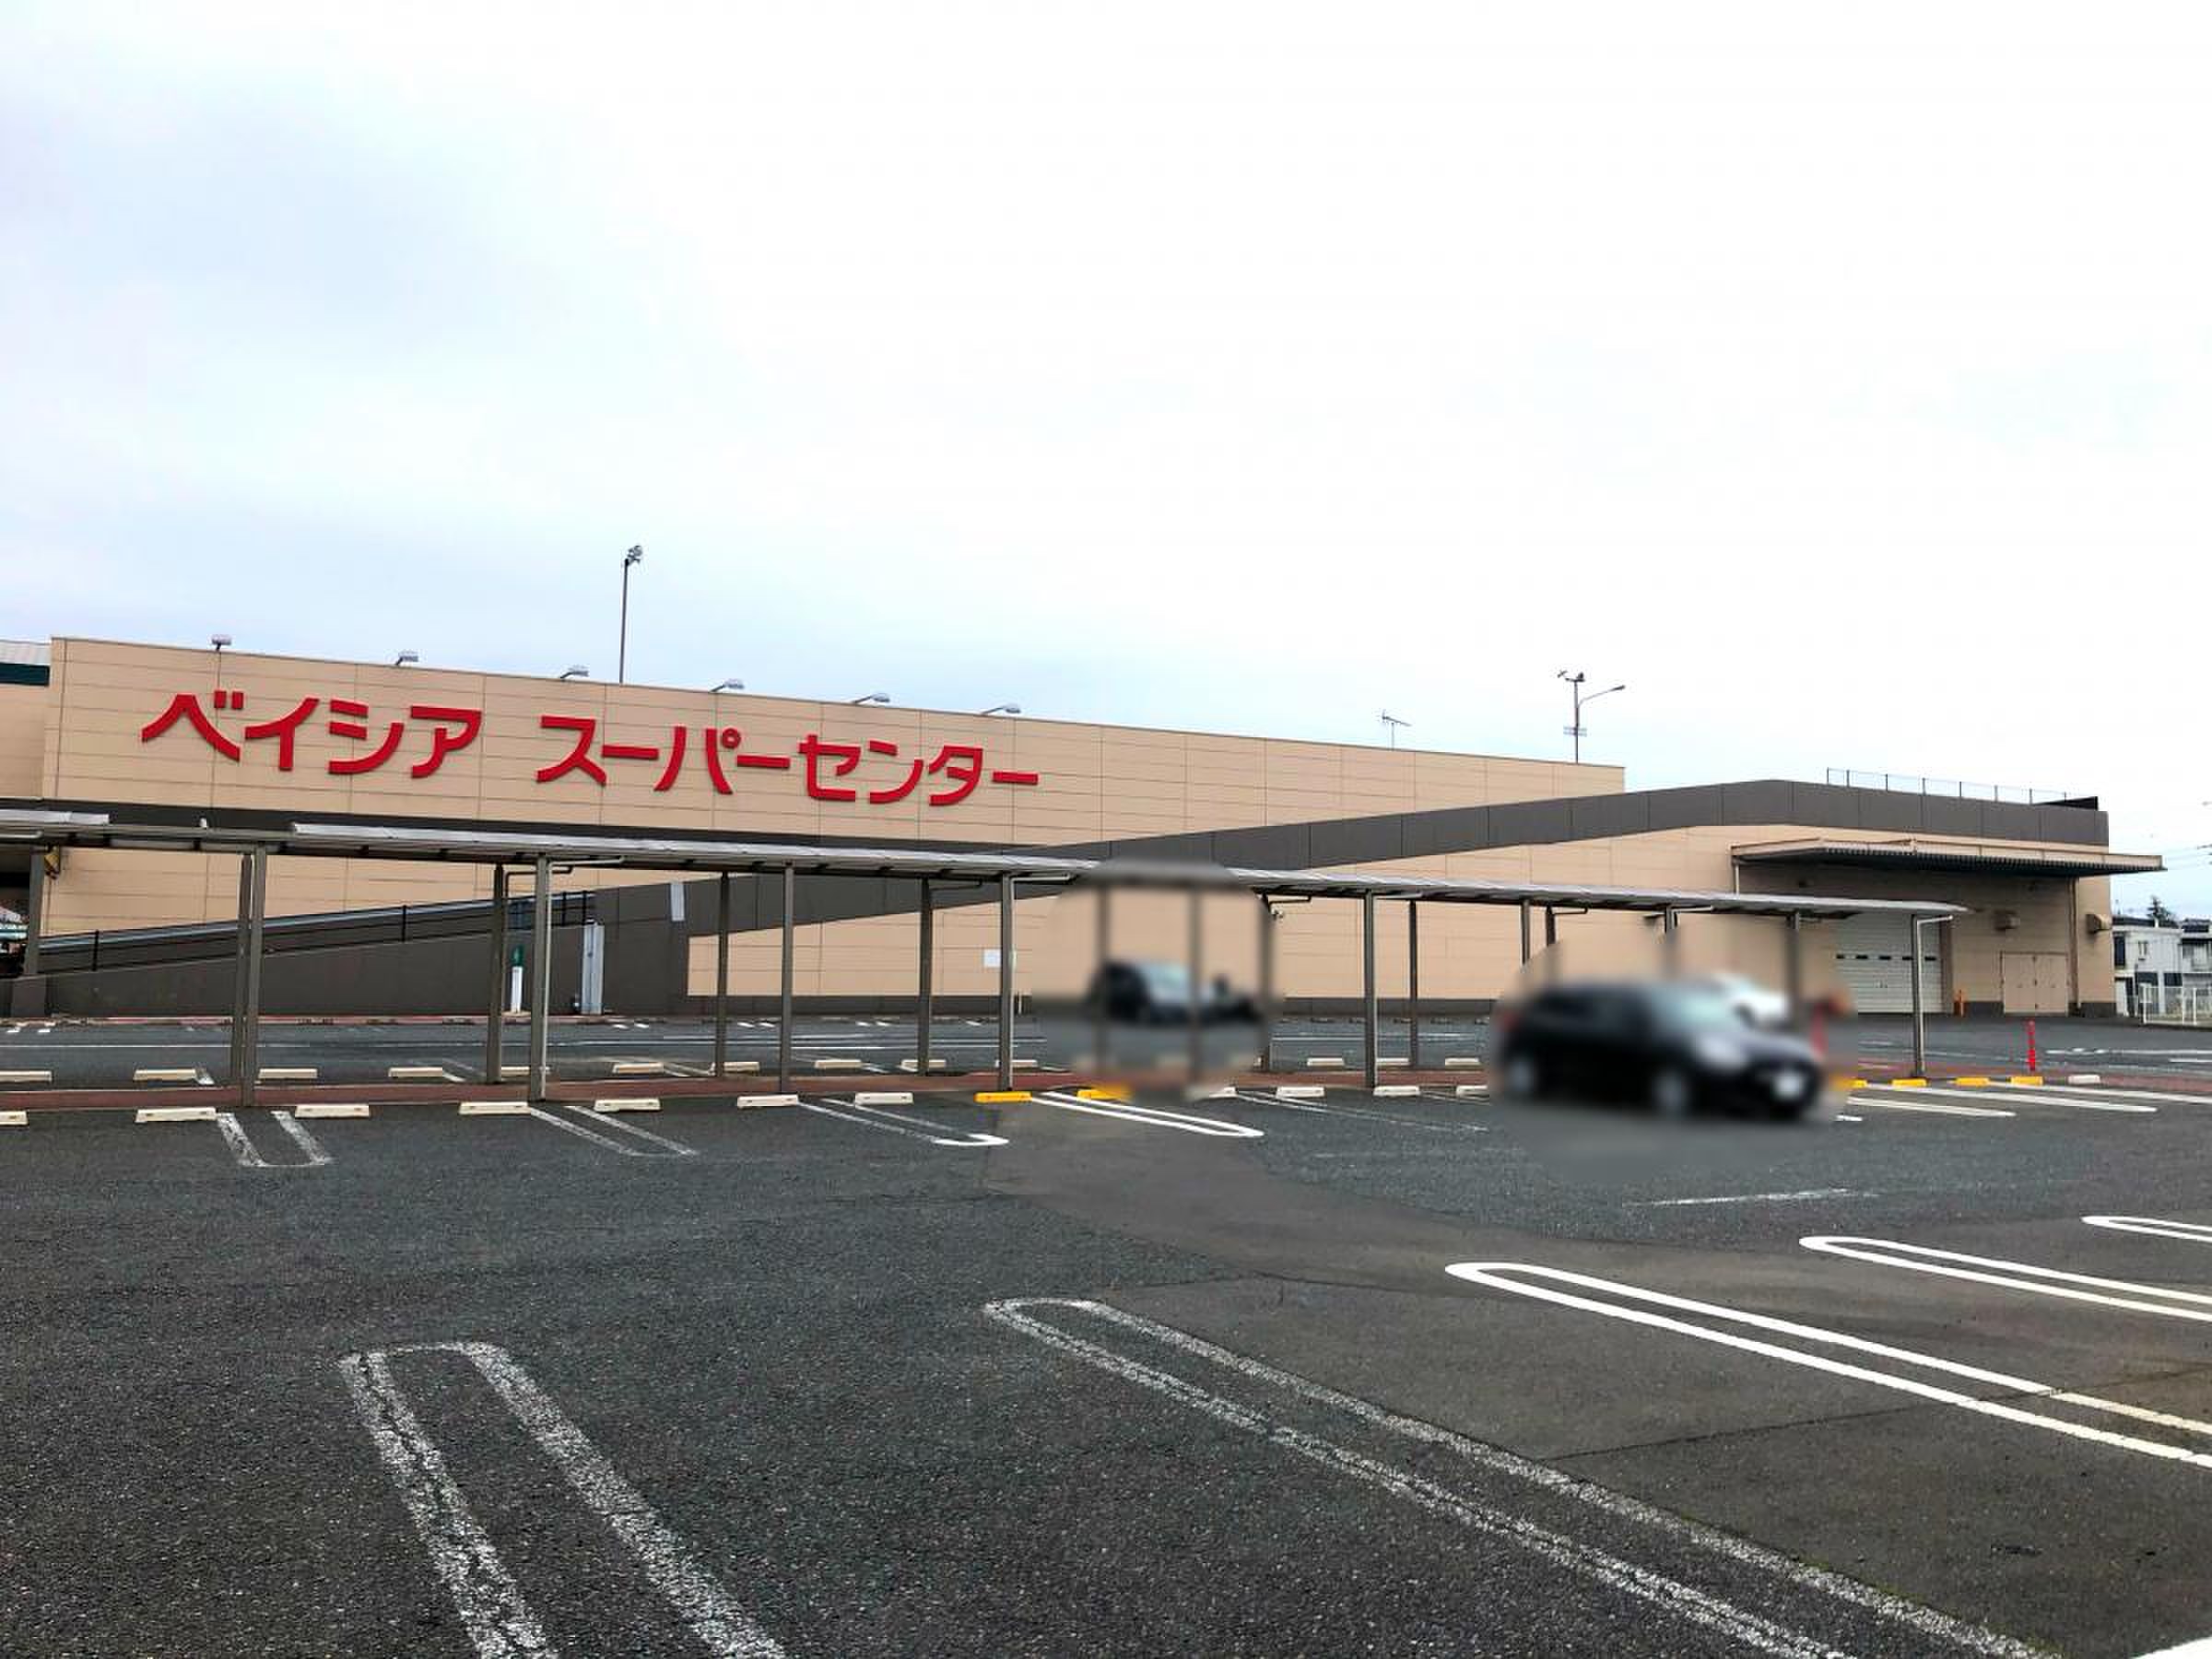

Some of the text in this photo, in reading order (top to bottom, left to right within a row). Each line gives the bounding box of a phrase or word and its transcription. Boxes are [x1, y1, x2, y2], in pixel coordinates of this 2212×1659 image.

[140, 689, 1040, 806] ベイシア スーパーセンター
